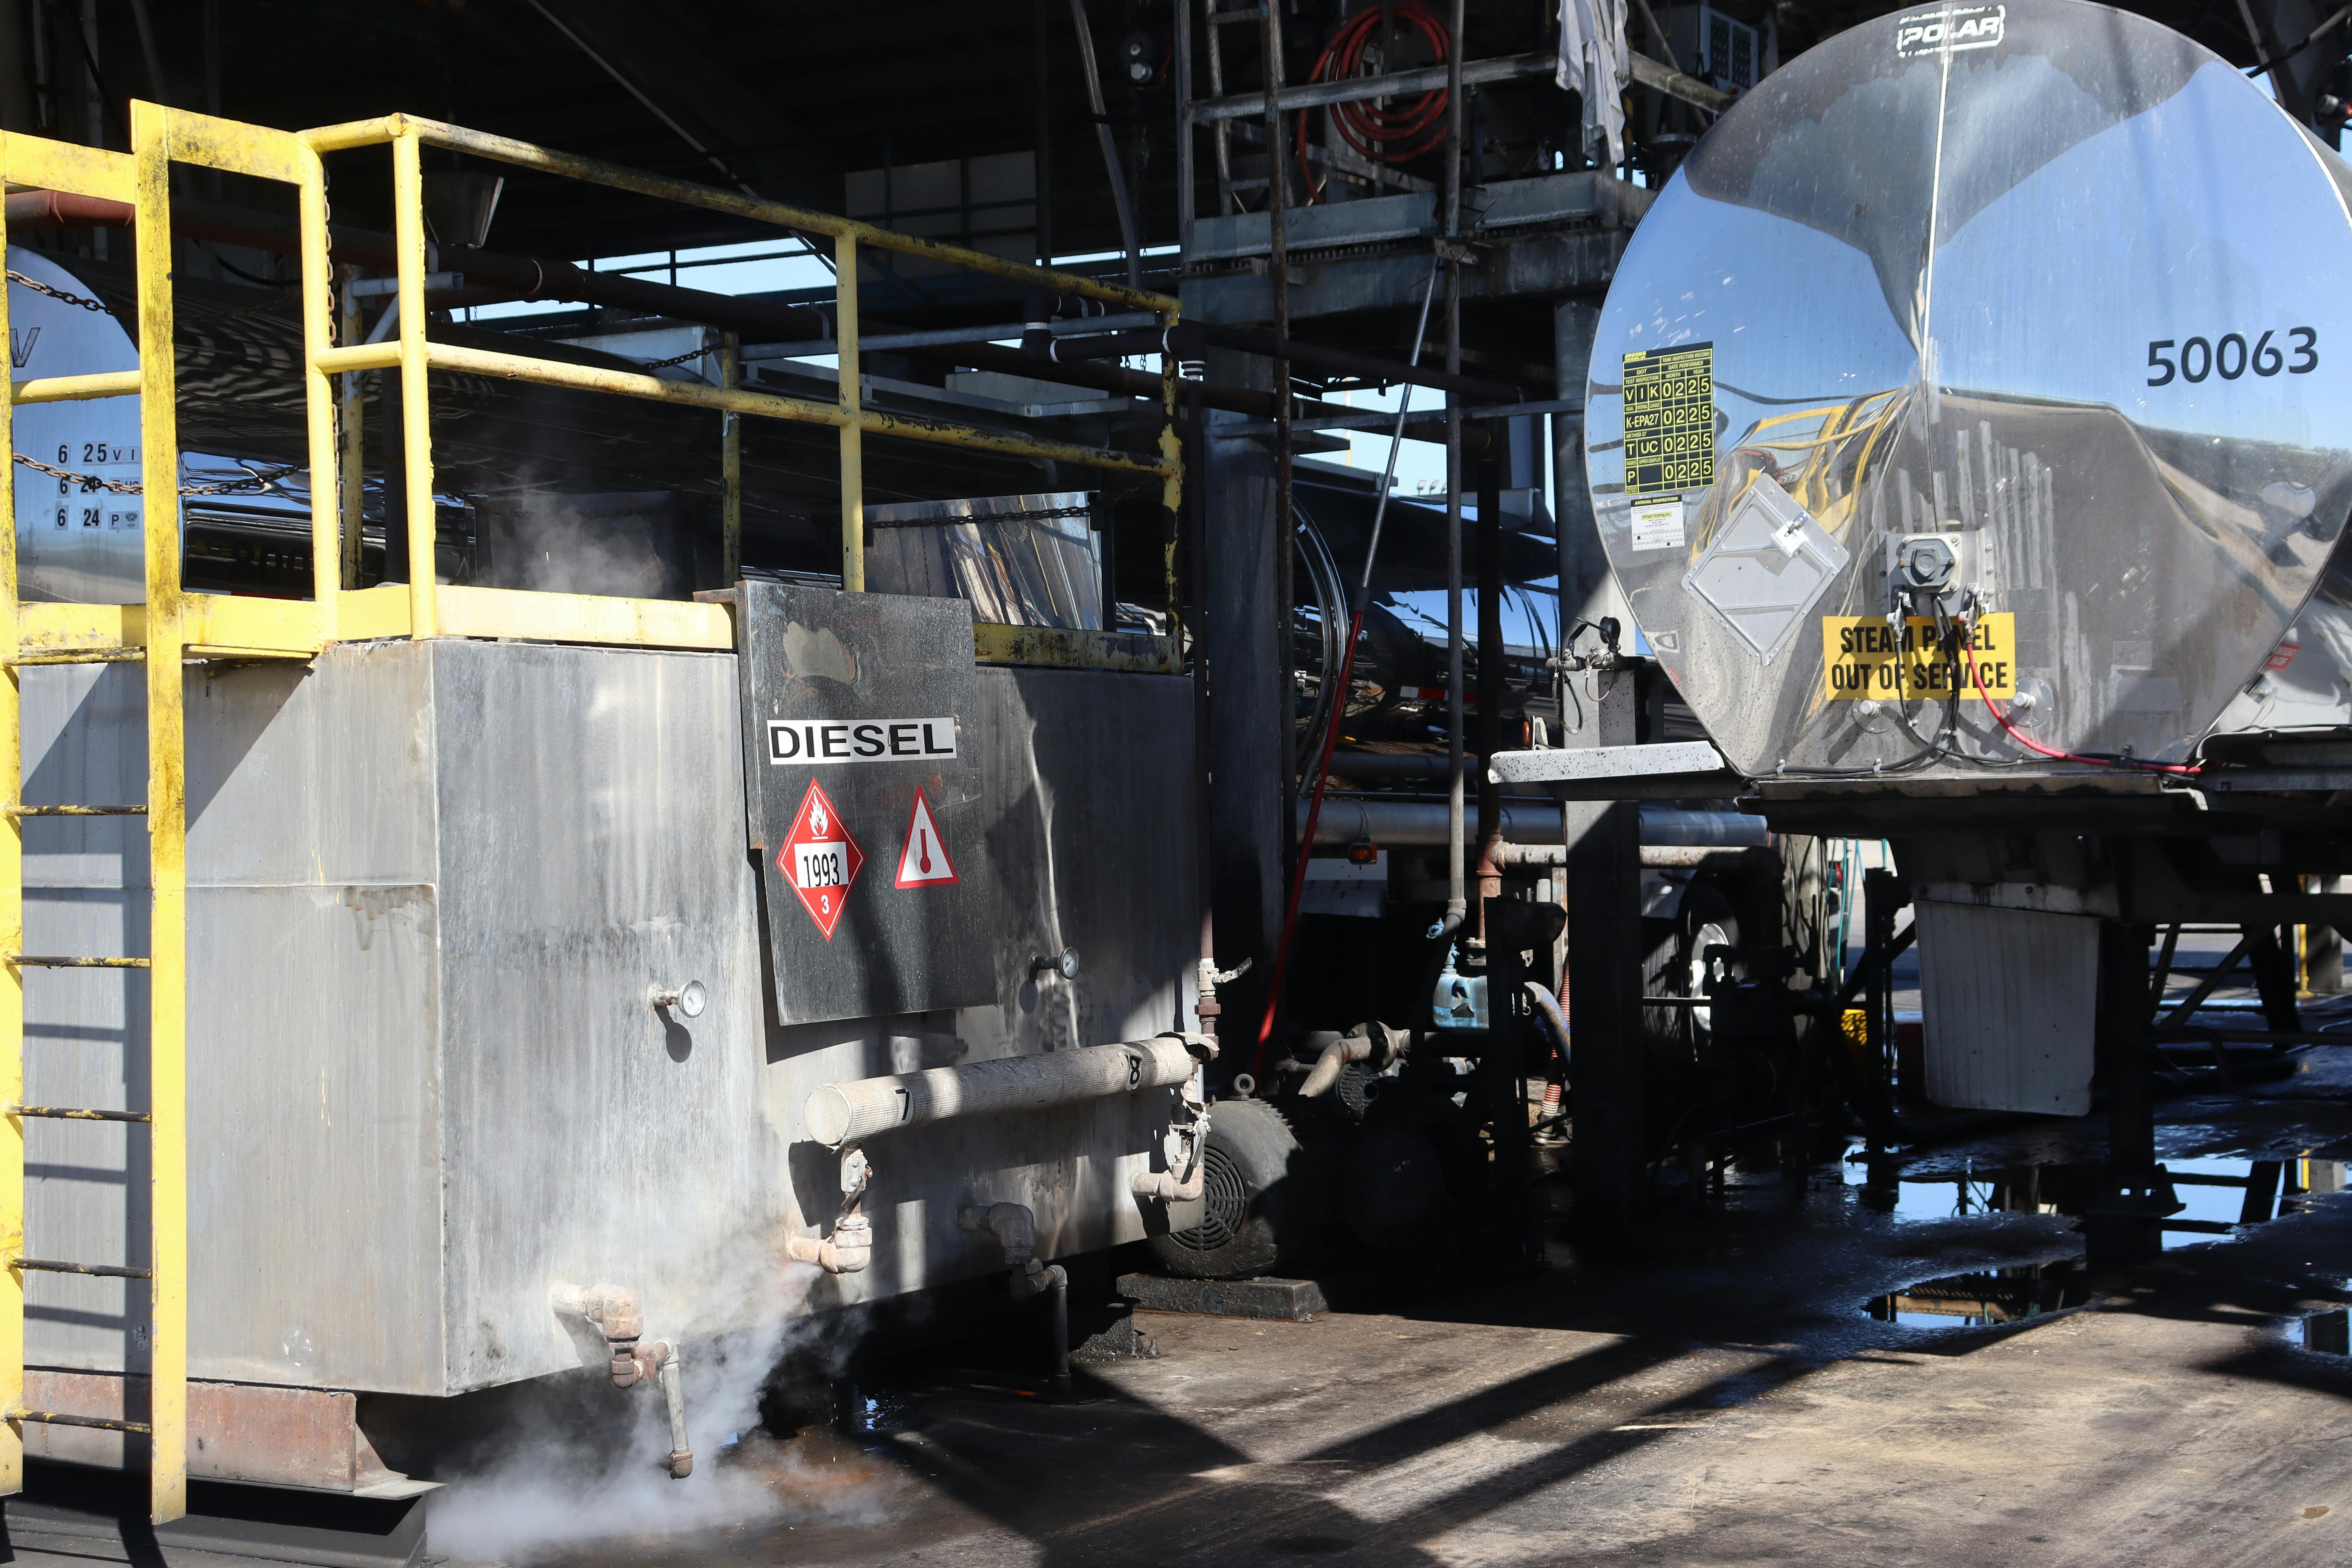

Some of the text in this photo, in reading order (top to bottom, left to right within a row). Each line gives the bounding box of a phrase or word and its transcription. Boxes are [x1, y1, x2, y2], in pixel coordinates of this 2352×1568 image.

[1902, 16, 2000, 46] POLAR
[2147, 326, 2319, 386] 50063
[1626, 413, 1659, 428] K-EPA27
[58, 443, 134, 463] 6 25 V I
[1627, 443, 1635, 455] T
[1641, 441, 1658, 454] UC
[60, 476, 68, 494] 6
[1628, 471, 1635, 483] P
[58, 508, 119, 526] 6 24 P
[1841, 625, 1914, 653] STEAM
[1832, 662, 2007, 690] OUT OF SERVICE
[770, 724, 953, 758] DIESEL
[804, 853, 840, 888] 1993
[821, 895, 829, 914] 3
[1129, 1055, 1141, 1085] 8
[895, 1088, 910, 1121] 7
